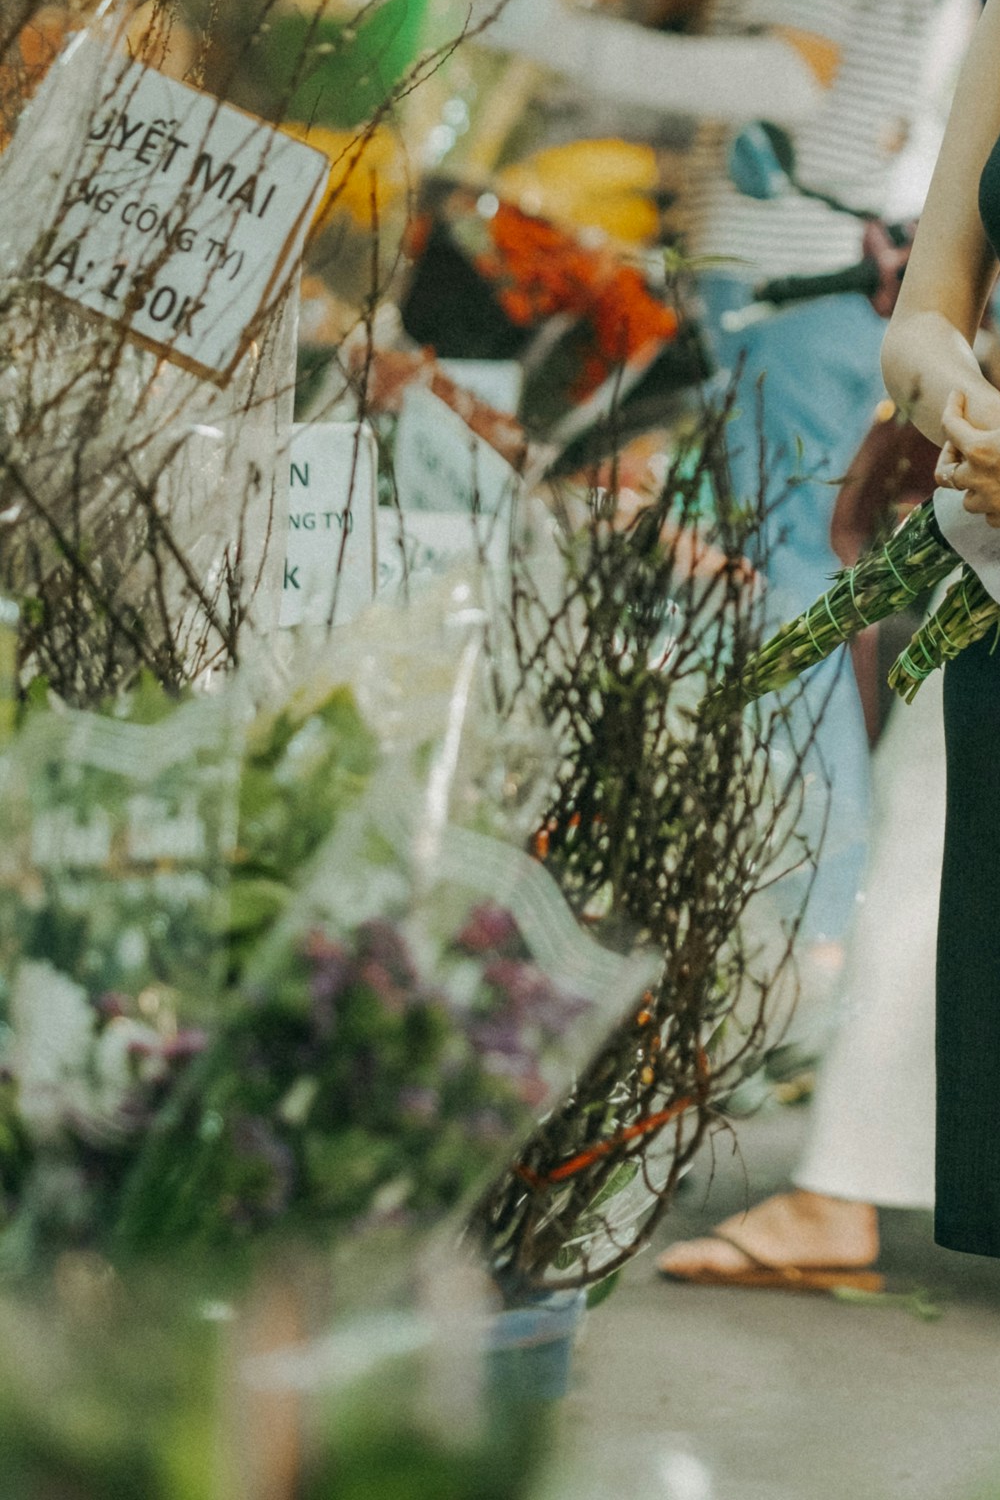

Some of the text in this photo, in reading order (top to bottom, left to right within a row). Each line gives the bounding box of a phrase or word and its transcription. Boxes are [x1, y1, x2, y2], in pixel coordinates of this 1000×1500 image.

[188, 152, 277, 218] MAI
[121, 202, 198, 253] CÔNG
[205, 238, 245, 281] TY)
[290, 462, 309, 487] N
[321, 510, 354, 534] TY)
